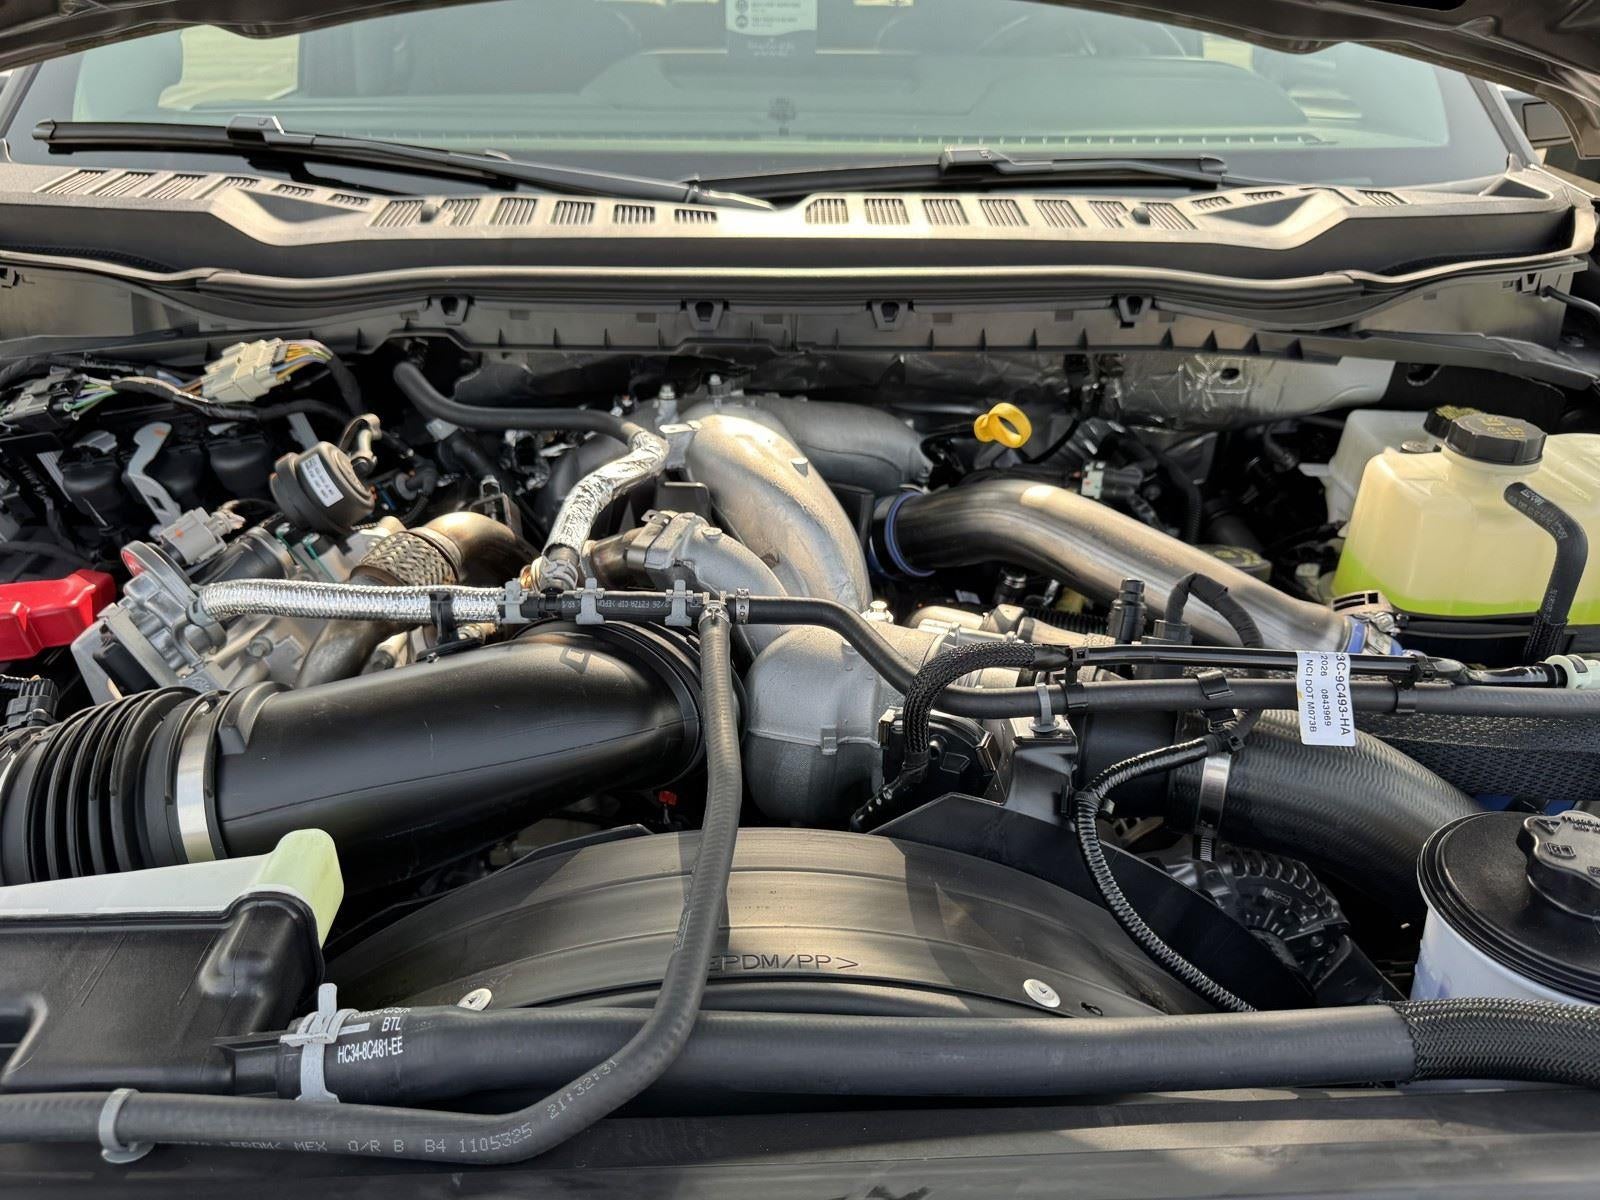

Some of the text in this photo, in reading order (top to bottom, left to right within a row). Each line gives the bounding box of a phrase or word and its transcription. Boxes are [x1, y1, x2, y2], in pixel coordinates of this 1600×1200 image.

[1305, 659, 1314, 676] NCI
[1305, 679, 1314, 699] DOT
[337, 1036, 404, 1064] HC34-8C481-EE
[393, 1139, 405, 1153] B
[424, 1138, 447, 1153] B4
[459, 1121, 533, 1153] 1105325
